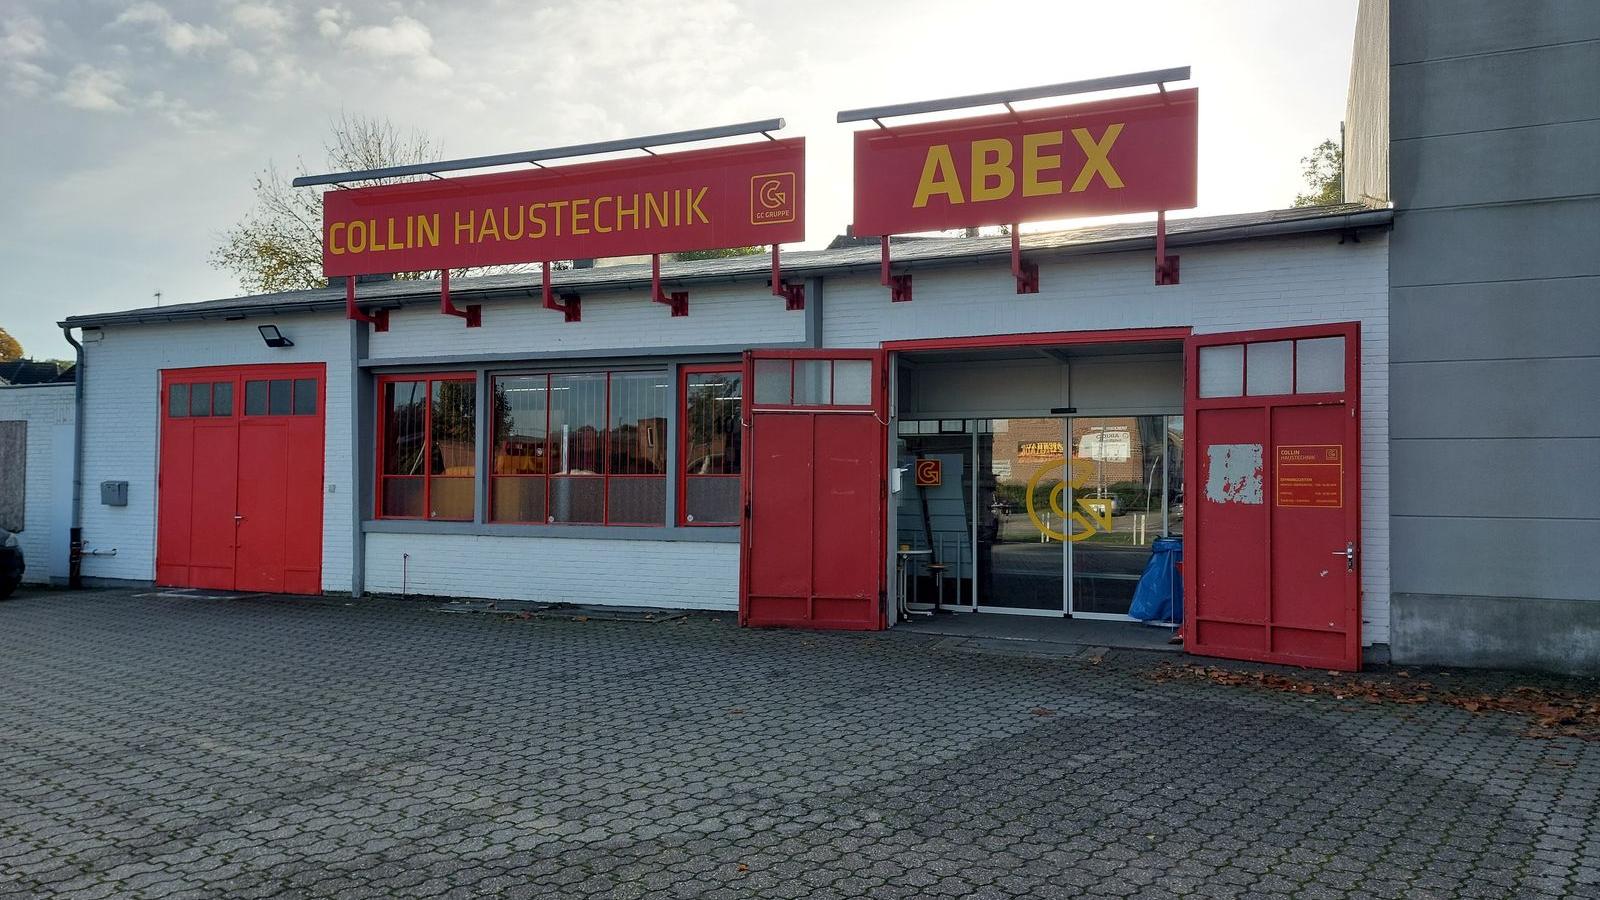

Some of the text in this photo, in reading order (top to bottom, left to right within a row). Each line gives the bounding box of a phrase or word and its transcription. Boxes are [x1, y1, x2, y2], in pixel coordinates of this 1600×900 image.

[912, 123, 1126, 208] ABEX
[329, 187, 709, 255] COLLIN HAUSTECHNIK
[765, 210, 790, 218] GRUPPE
